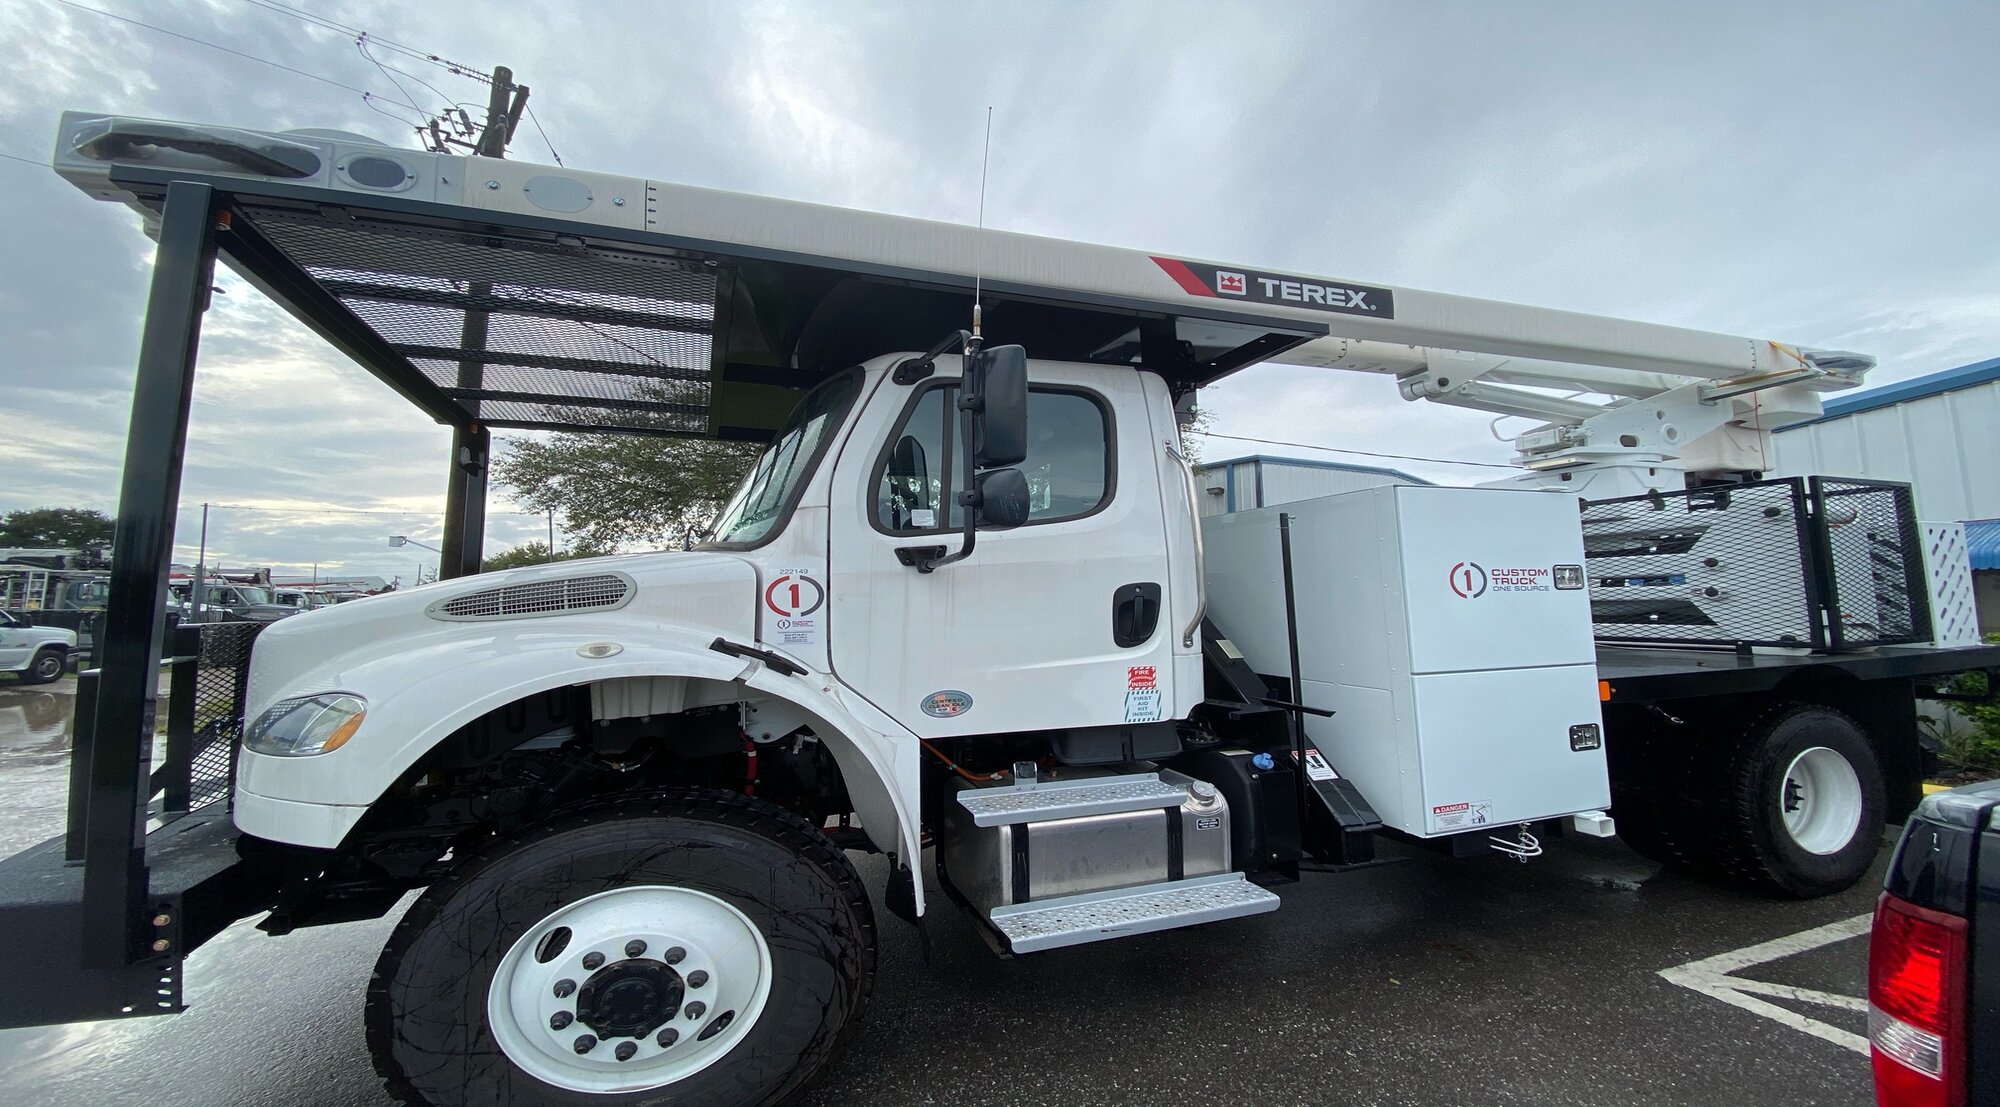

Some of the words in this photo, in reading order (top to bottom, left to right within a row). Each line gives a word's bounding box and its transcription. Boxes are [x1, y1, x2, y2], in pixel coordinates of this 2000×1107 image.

[1257, 277, 1369, 310] TEREX
[1491, 568, 1549, 577] CUSTOM
[1492, 577, 1537, 585] TRUCK
[1440, 804, 1468, 812] DANGER
